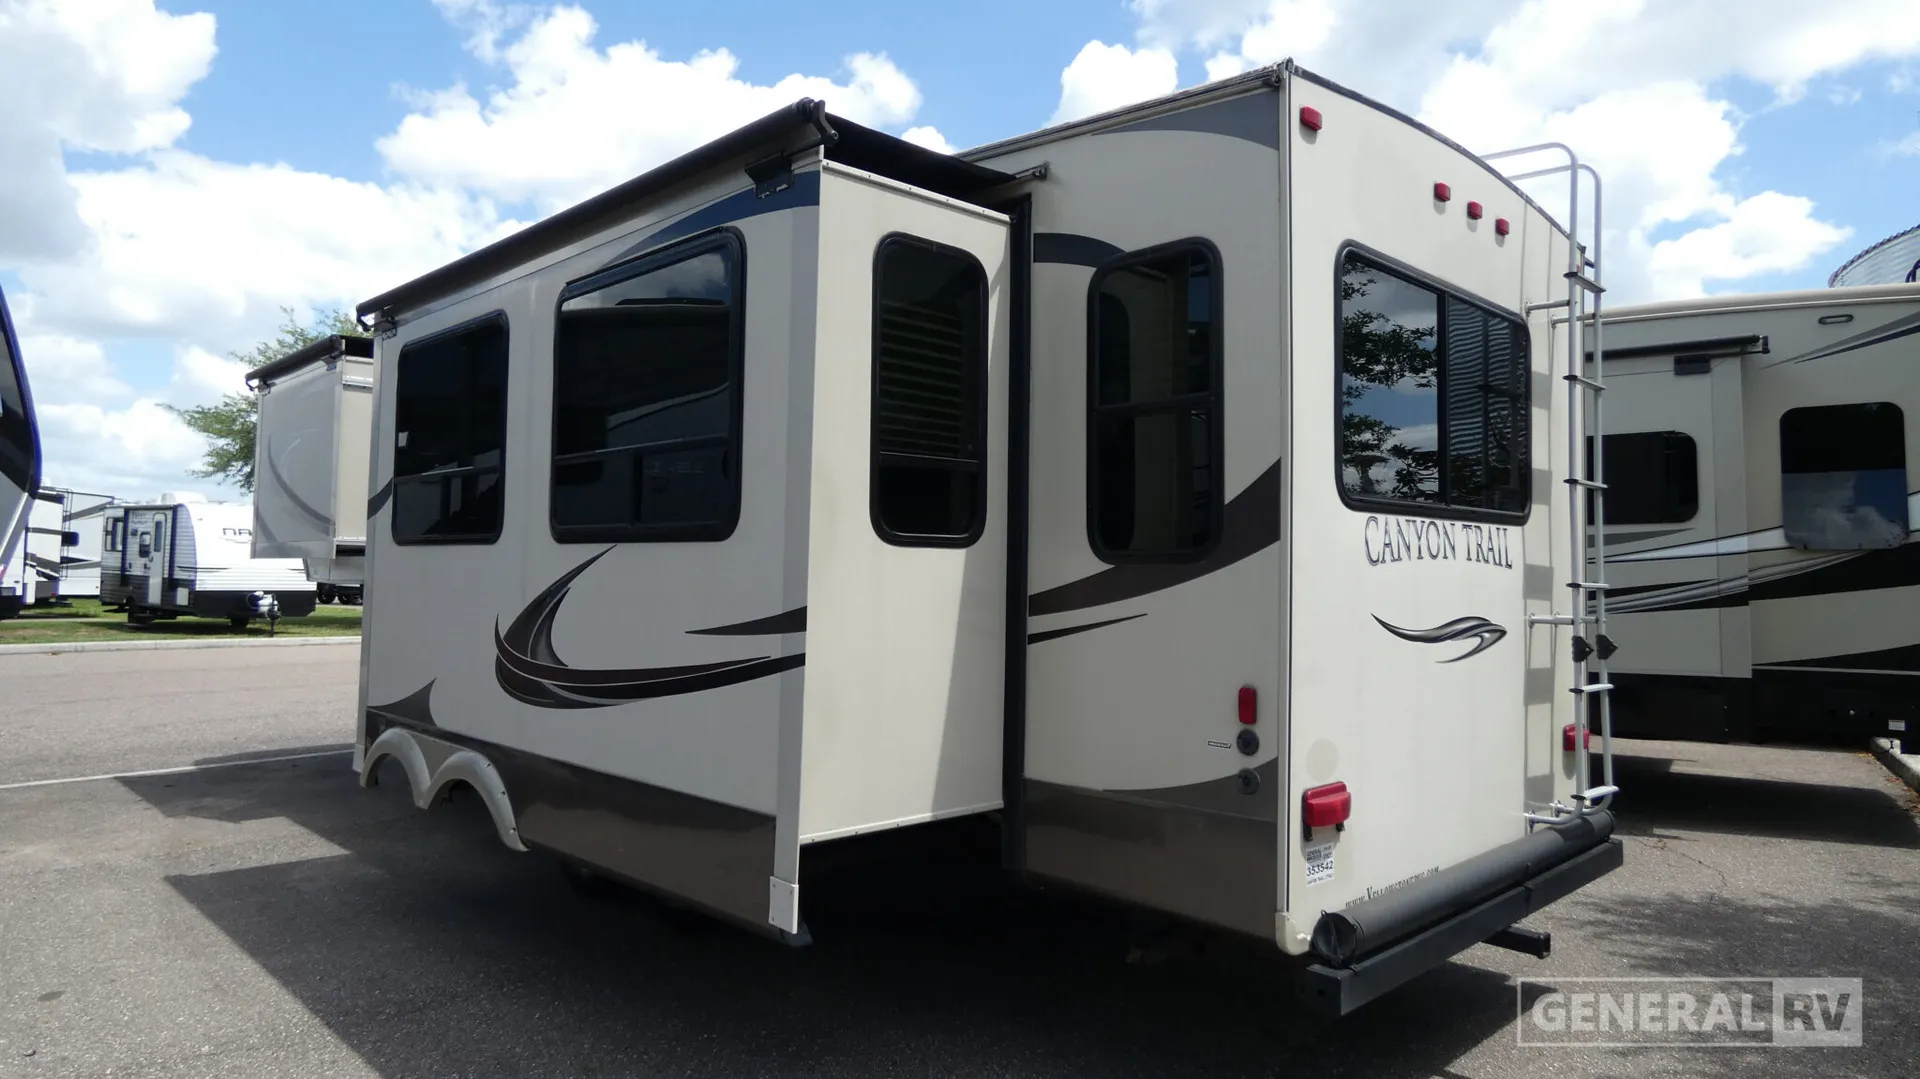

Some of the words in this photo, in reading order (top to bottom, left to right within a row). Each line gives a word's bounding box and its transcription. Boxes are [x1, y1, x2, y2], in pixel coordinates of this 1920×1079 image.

[1364, 515, 1456, 566] CANYON
[1462, 524, 1513, 569] TRAIL
[1306, 860, 1334, 877] 353542
